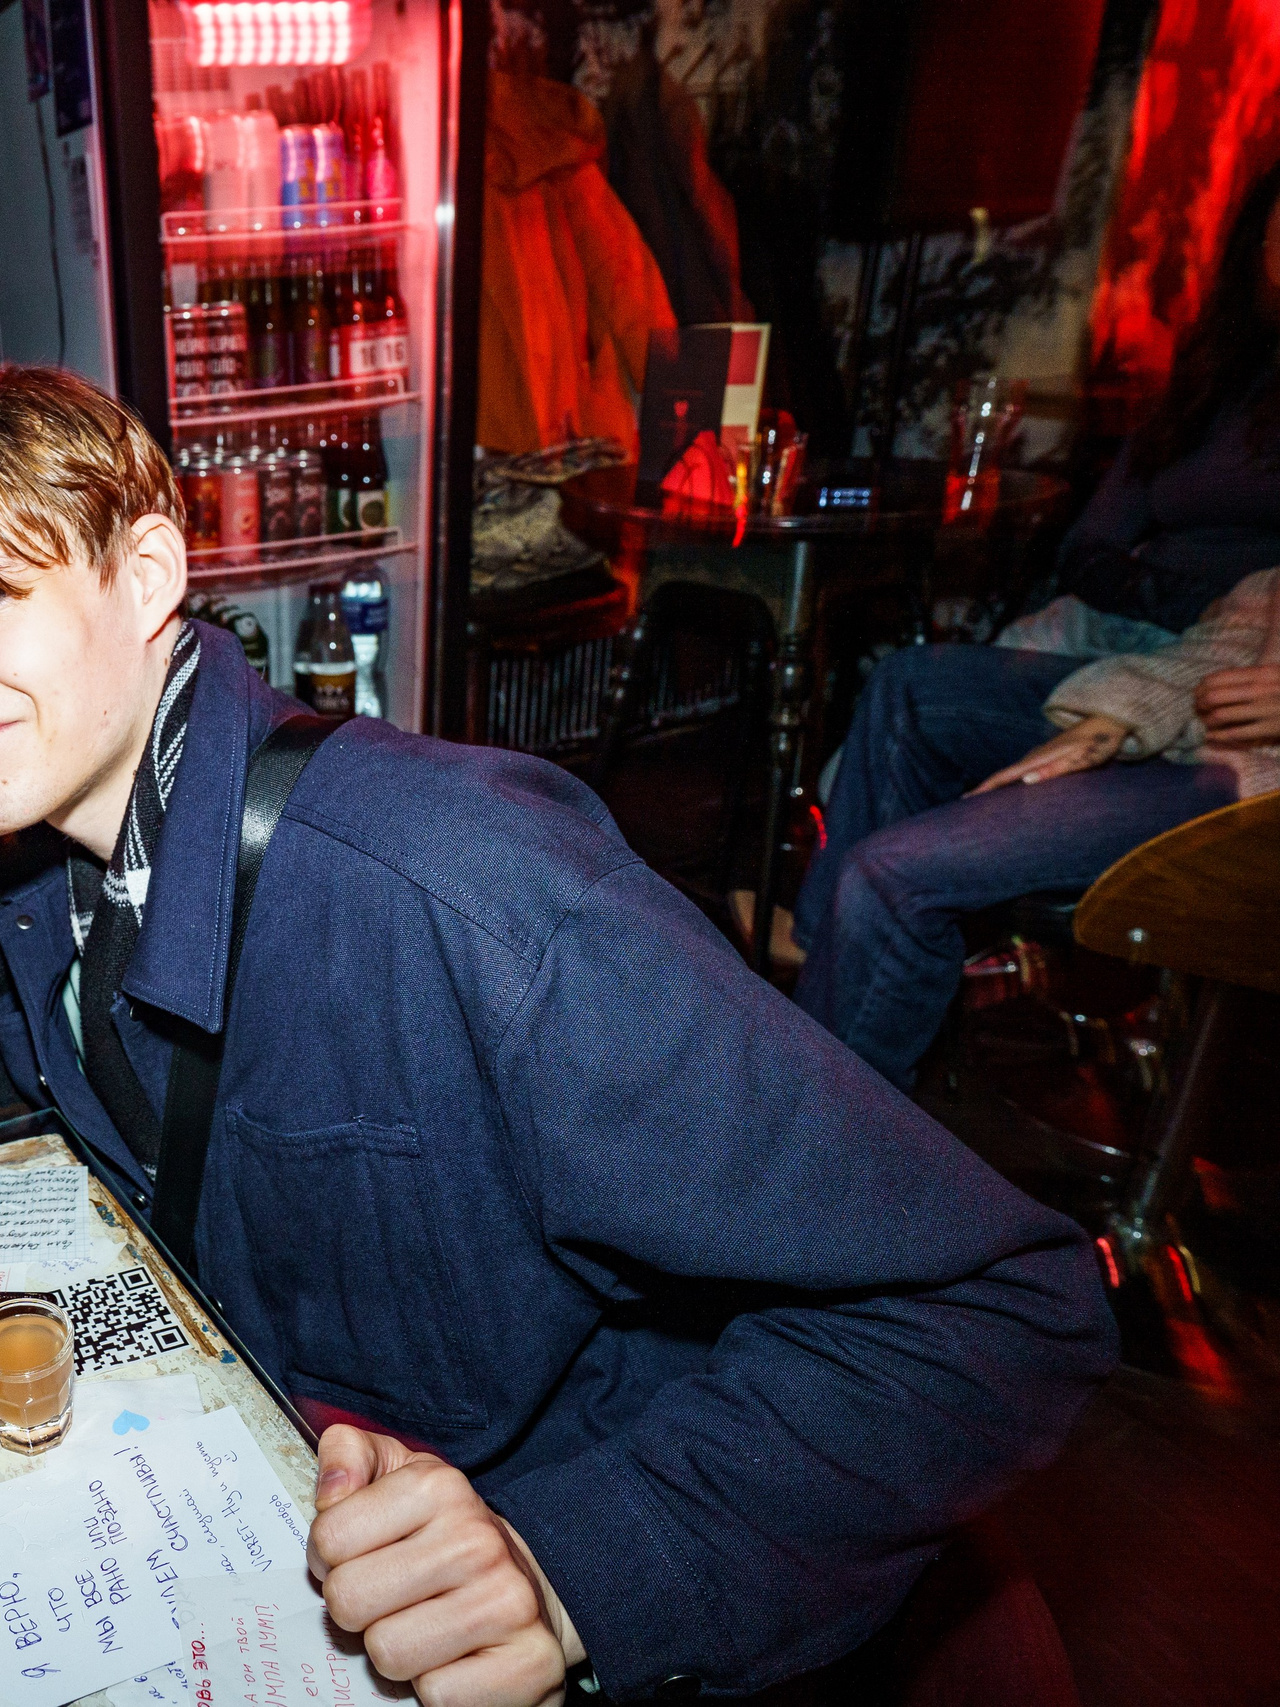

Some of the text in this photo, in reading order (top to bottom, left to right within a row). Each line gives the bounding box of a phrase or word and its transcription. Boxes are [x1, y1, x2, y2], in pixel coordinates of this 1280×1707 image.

[88, 1479, 128, 1546] ПОЗДНО
[113, 1446, 189, 1552] СЧАСТЛИВЫ!
[178, 1488, 218, 1544] слушай
[83, 1515, 133, 1607] РАНО ИЛИ
[47, 1587, 73, 1633] ЧТО
[74, 1568, 124, 1655] МЫ ВСЕ
[20, 1662, 62, 1679] Я
